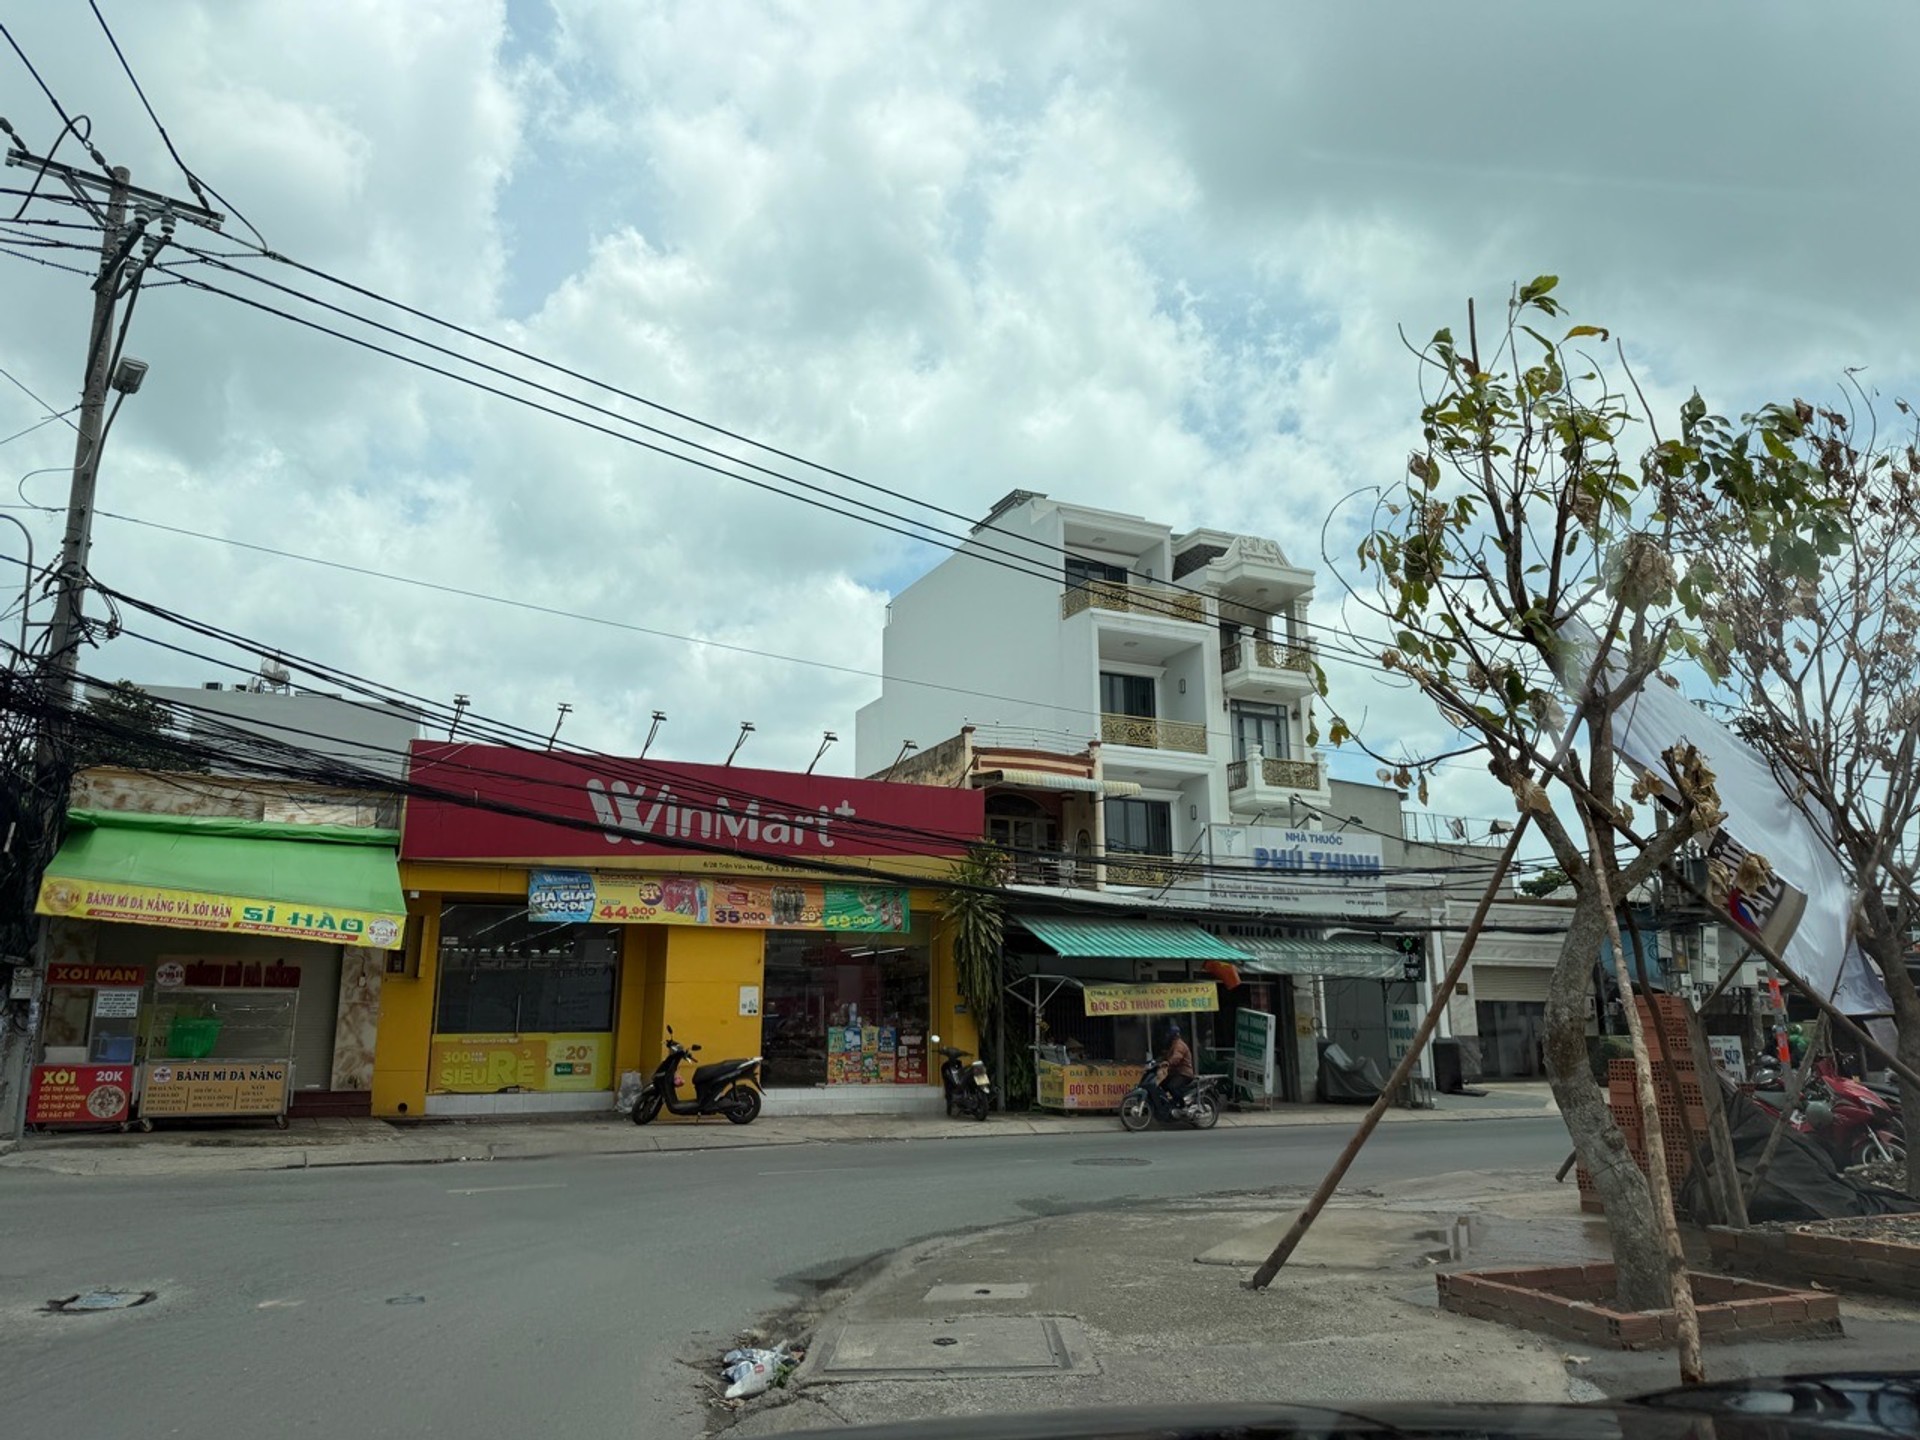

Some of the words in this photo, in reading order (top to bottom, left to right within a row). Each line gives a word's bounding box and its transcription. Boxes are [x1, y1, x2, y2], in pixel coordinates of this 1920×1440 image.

[1286, 832, 1307, 843] NHÀ
[1310, 832, 1343, 845] THUỐC
[1254, 844, 1303, 874] PHÚ
[86, 889, 115, 907] BÁNH
[116, 892, 129, 908] MÌ
[177, 899, 189, 914] VÀ
[192, 900, 210, 916] XÔI
[442, 1051, 470, 1063] 300
[41, 1068, 77, 1085] XÔI
[95, 1070, 124, 1082] 20K
[176, 1068, 210, 1081] BÁNH
[212, 1068, 226, 1081] MÌ
[229, 1068, 246, 1081] ĐÀ
[440, 1064, 487, 1086] SIÊU
